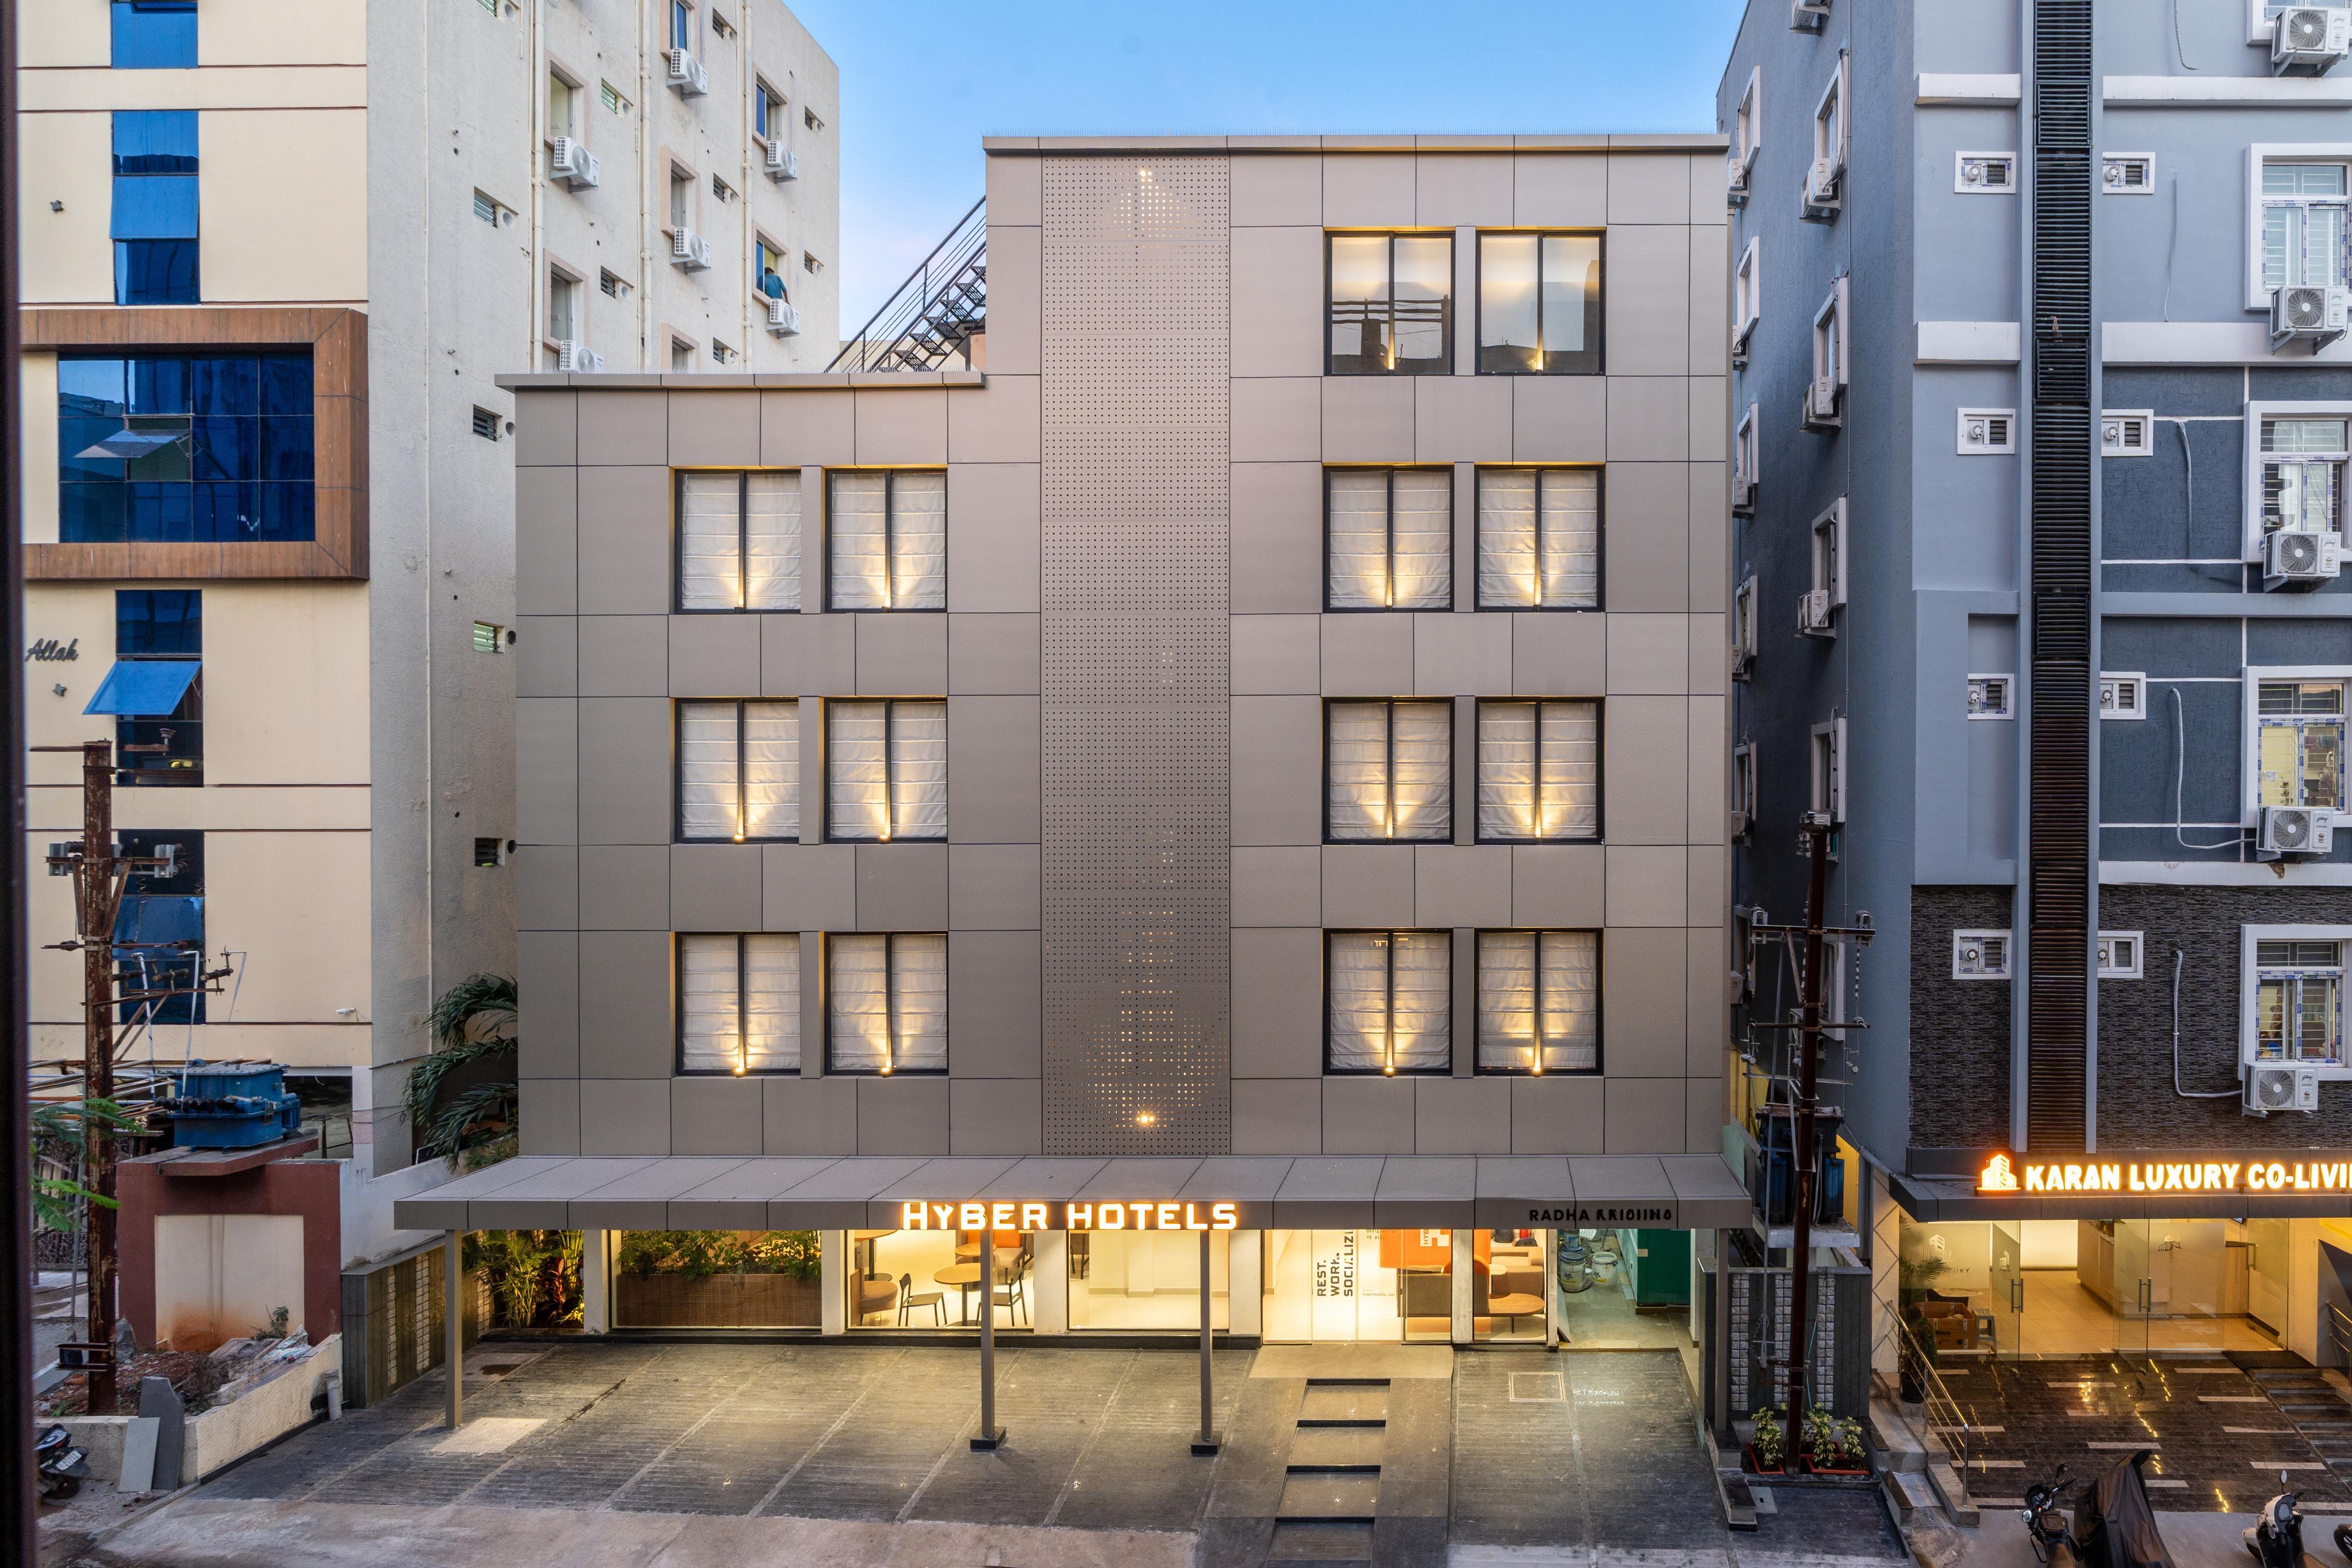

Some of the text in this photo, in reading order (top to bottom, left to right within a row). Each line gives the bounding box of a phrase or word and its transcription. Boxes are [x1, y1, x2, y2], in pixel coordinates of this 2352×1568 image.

[25, 638, 79, 662] Allah
[2026, 1163, 2352, 1190] KARAN LUXURY CO-LIVI
[903, 1202, 1237, 1230] HYBER HOTELS
[1529, 1209, 1590, 1221] RADHA
[1317, 1260, 1327, 1296] REST.
